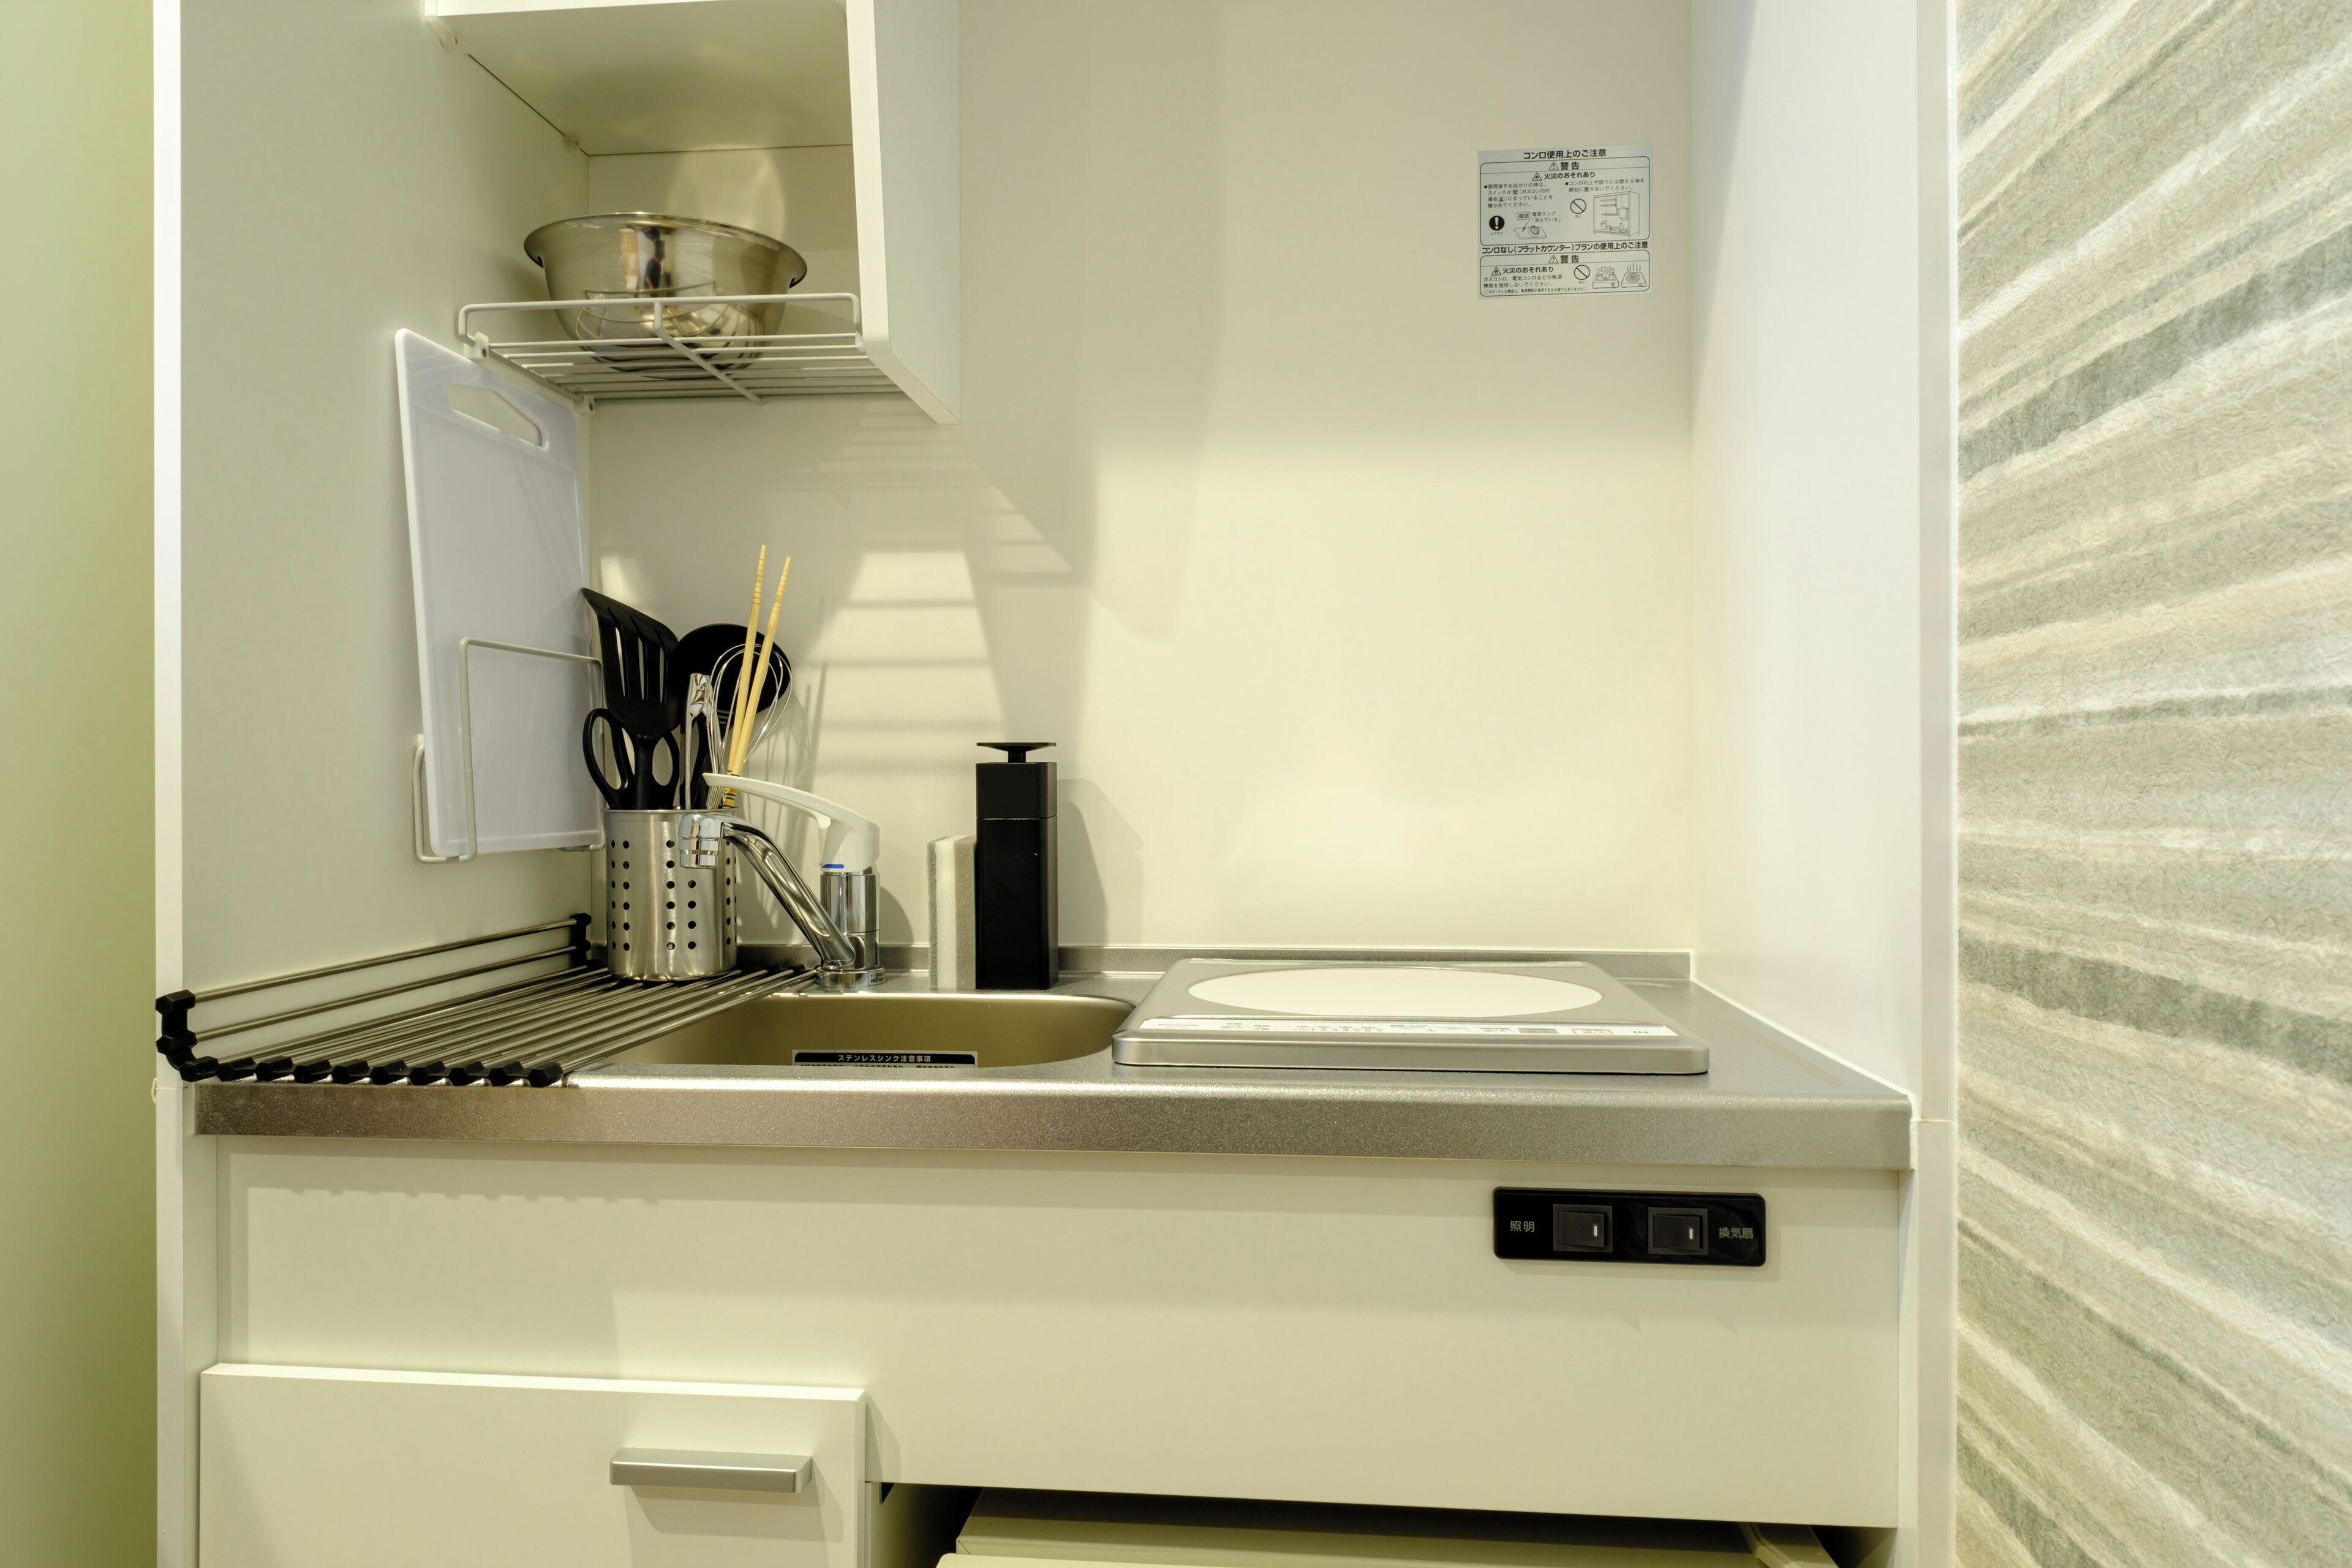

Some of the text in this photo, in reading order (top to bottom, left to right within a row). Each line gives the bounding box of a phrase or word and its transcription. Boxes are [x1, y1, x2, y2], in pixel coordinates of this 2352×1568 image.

[1523, 148, 1607, 159] コンロ使用上のご注意
[1560, 161, 1580, 171] 警告
[1560, 255, 1580, 264] 警告
[837, 1054, 932, 1063] ステンレスシンク注意事項
[1509, 1220, 1535, 1233] 照明
[1717, 1227, 1754, 1240] 換気扇
